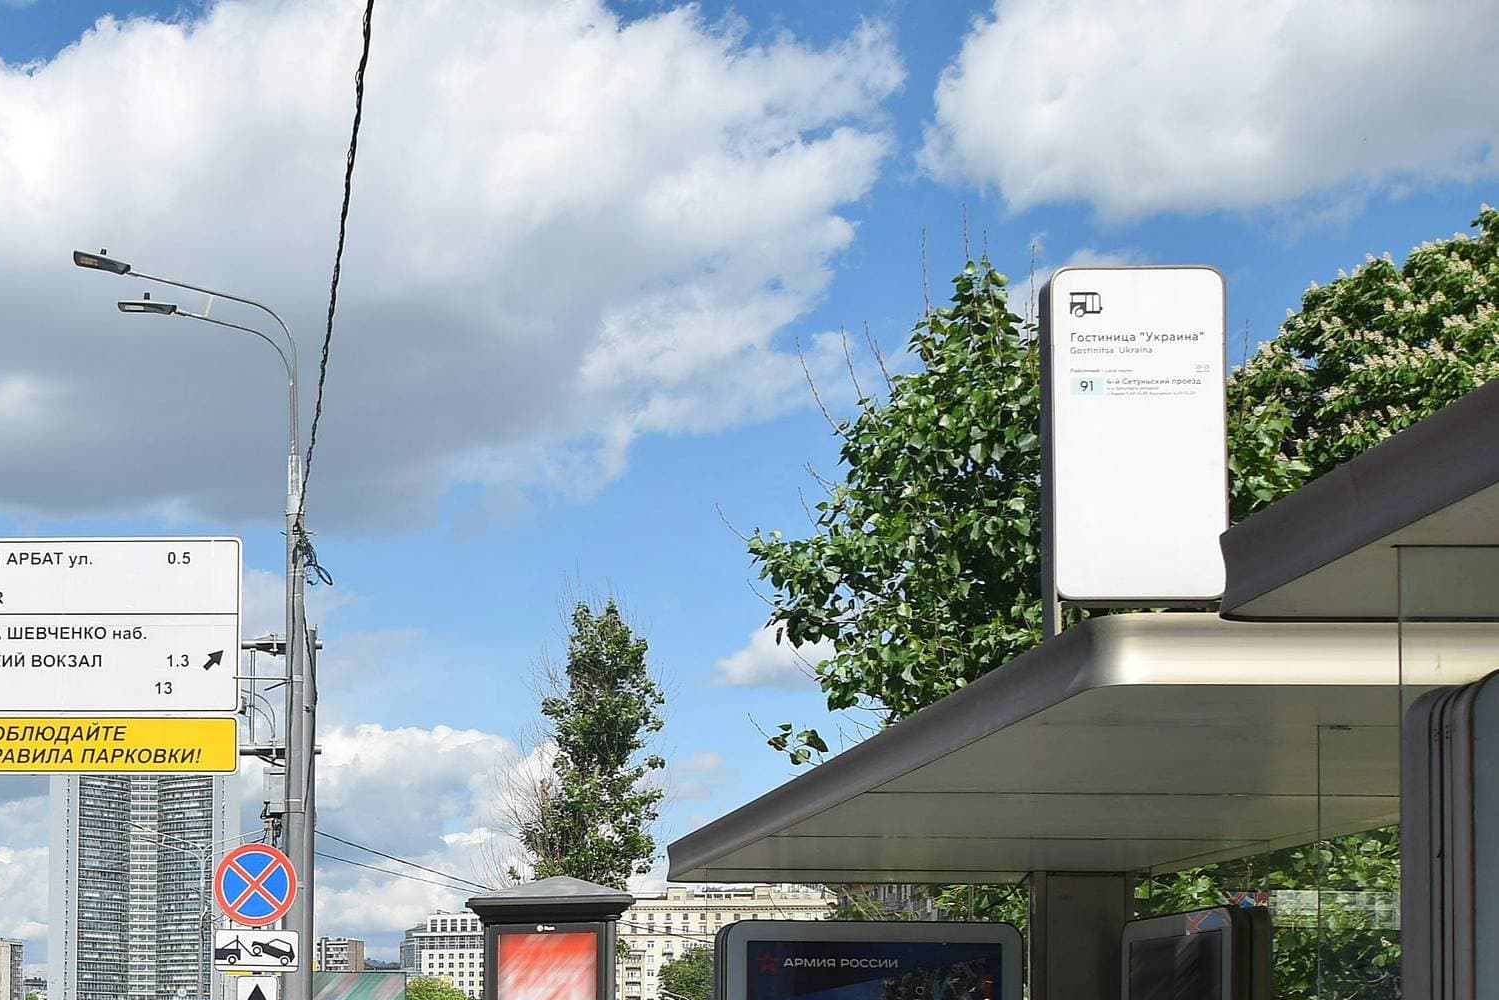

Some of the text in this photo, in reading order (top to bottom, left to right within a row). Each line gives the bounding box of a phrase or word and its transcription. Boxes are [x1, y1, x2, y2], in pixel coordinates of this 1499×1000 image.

[1070, 331, 1205, 343] Гостиница "Украина"
[1069, 346, 1153, 354] Gostinitsa Ukraina
[1080, 380, 1094, 392] 91
[7, 552, 63, 566] АРБАТ
[68, 554, 93, 569] ул.
[167, 551, 191, 565] 0.5
[7, 626, 107, 640] ШЕВЧЕНКО
[112, 628, 147, 640] наб.
[31, 654, 102, 668] ВОКЗАЛ
[166, 655, 190, 668] 1.3
[155, 682, 173, 695] 13
[81, 747, 202, 764] ПАРКОВКИ!
[783, 957, 898, 968] АРМИЯ РОССИИ
